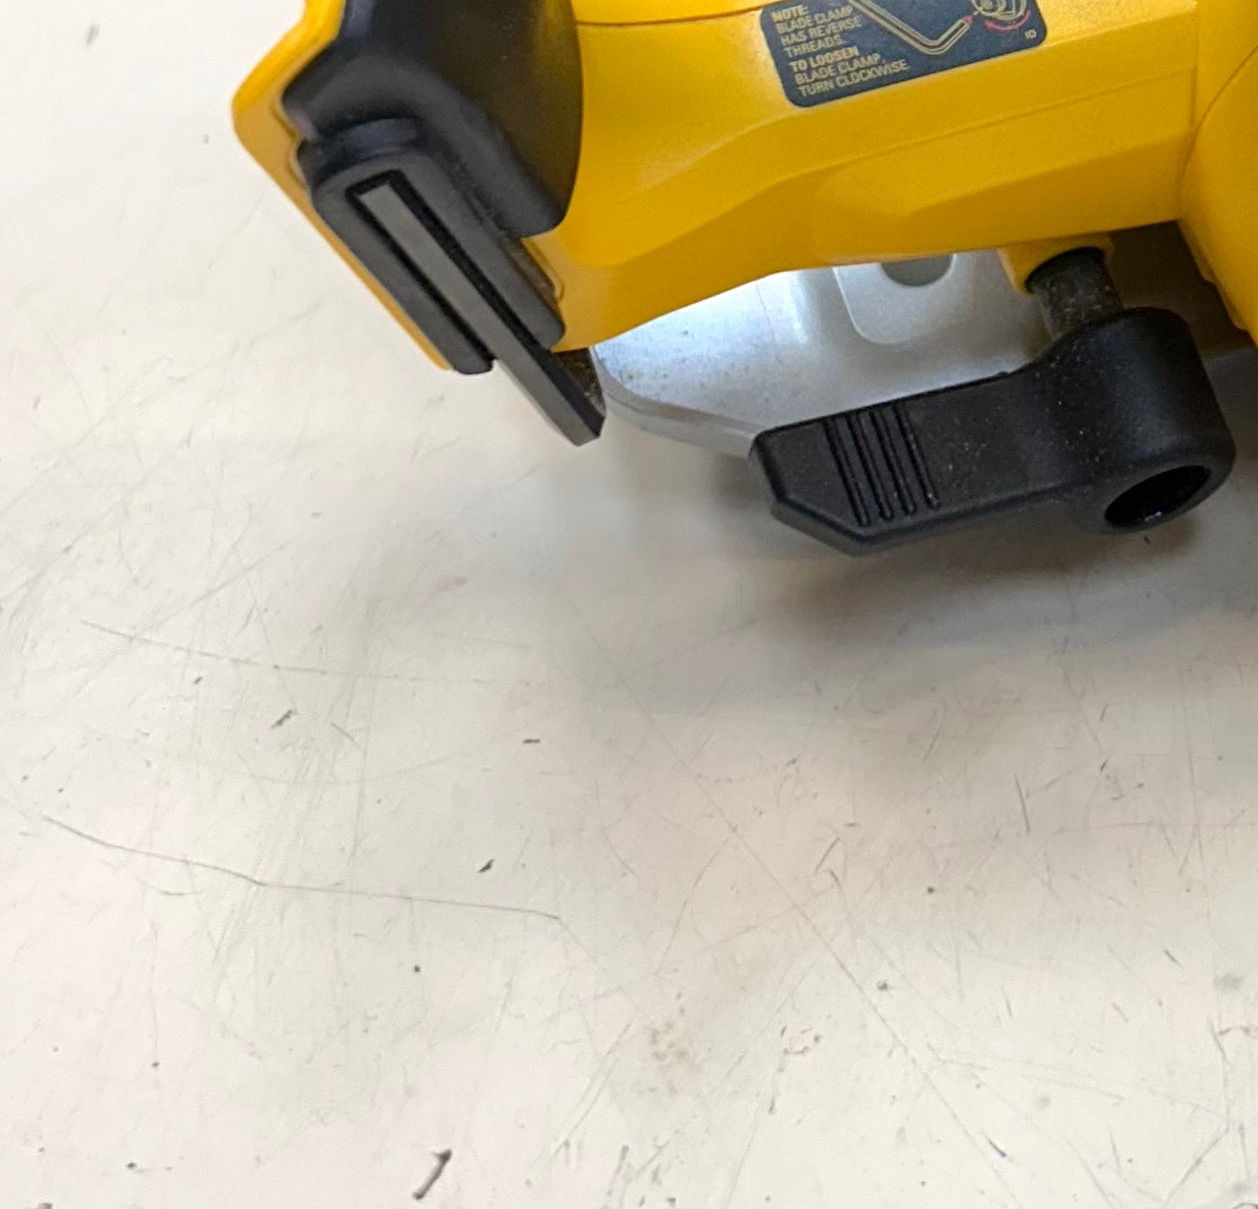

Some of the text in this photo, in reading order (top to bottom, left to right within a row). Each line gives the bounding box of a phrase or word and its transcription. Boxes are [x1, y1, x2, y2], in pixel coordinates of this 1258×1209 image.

[771, 3, 810, 22] NOTE:
[775, 5, 855, 34] BLADE CLAMP
[780, 16, 862, 46] HAS REVERSE
[790, 45, 859, 72] TO LOOSEN
[794, 64, 837, 85] BLADE
[799, 78, 835, 97] TURN
